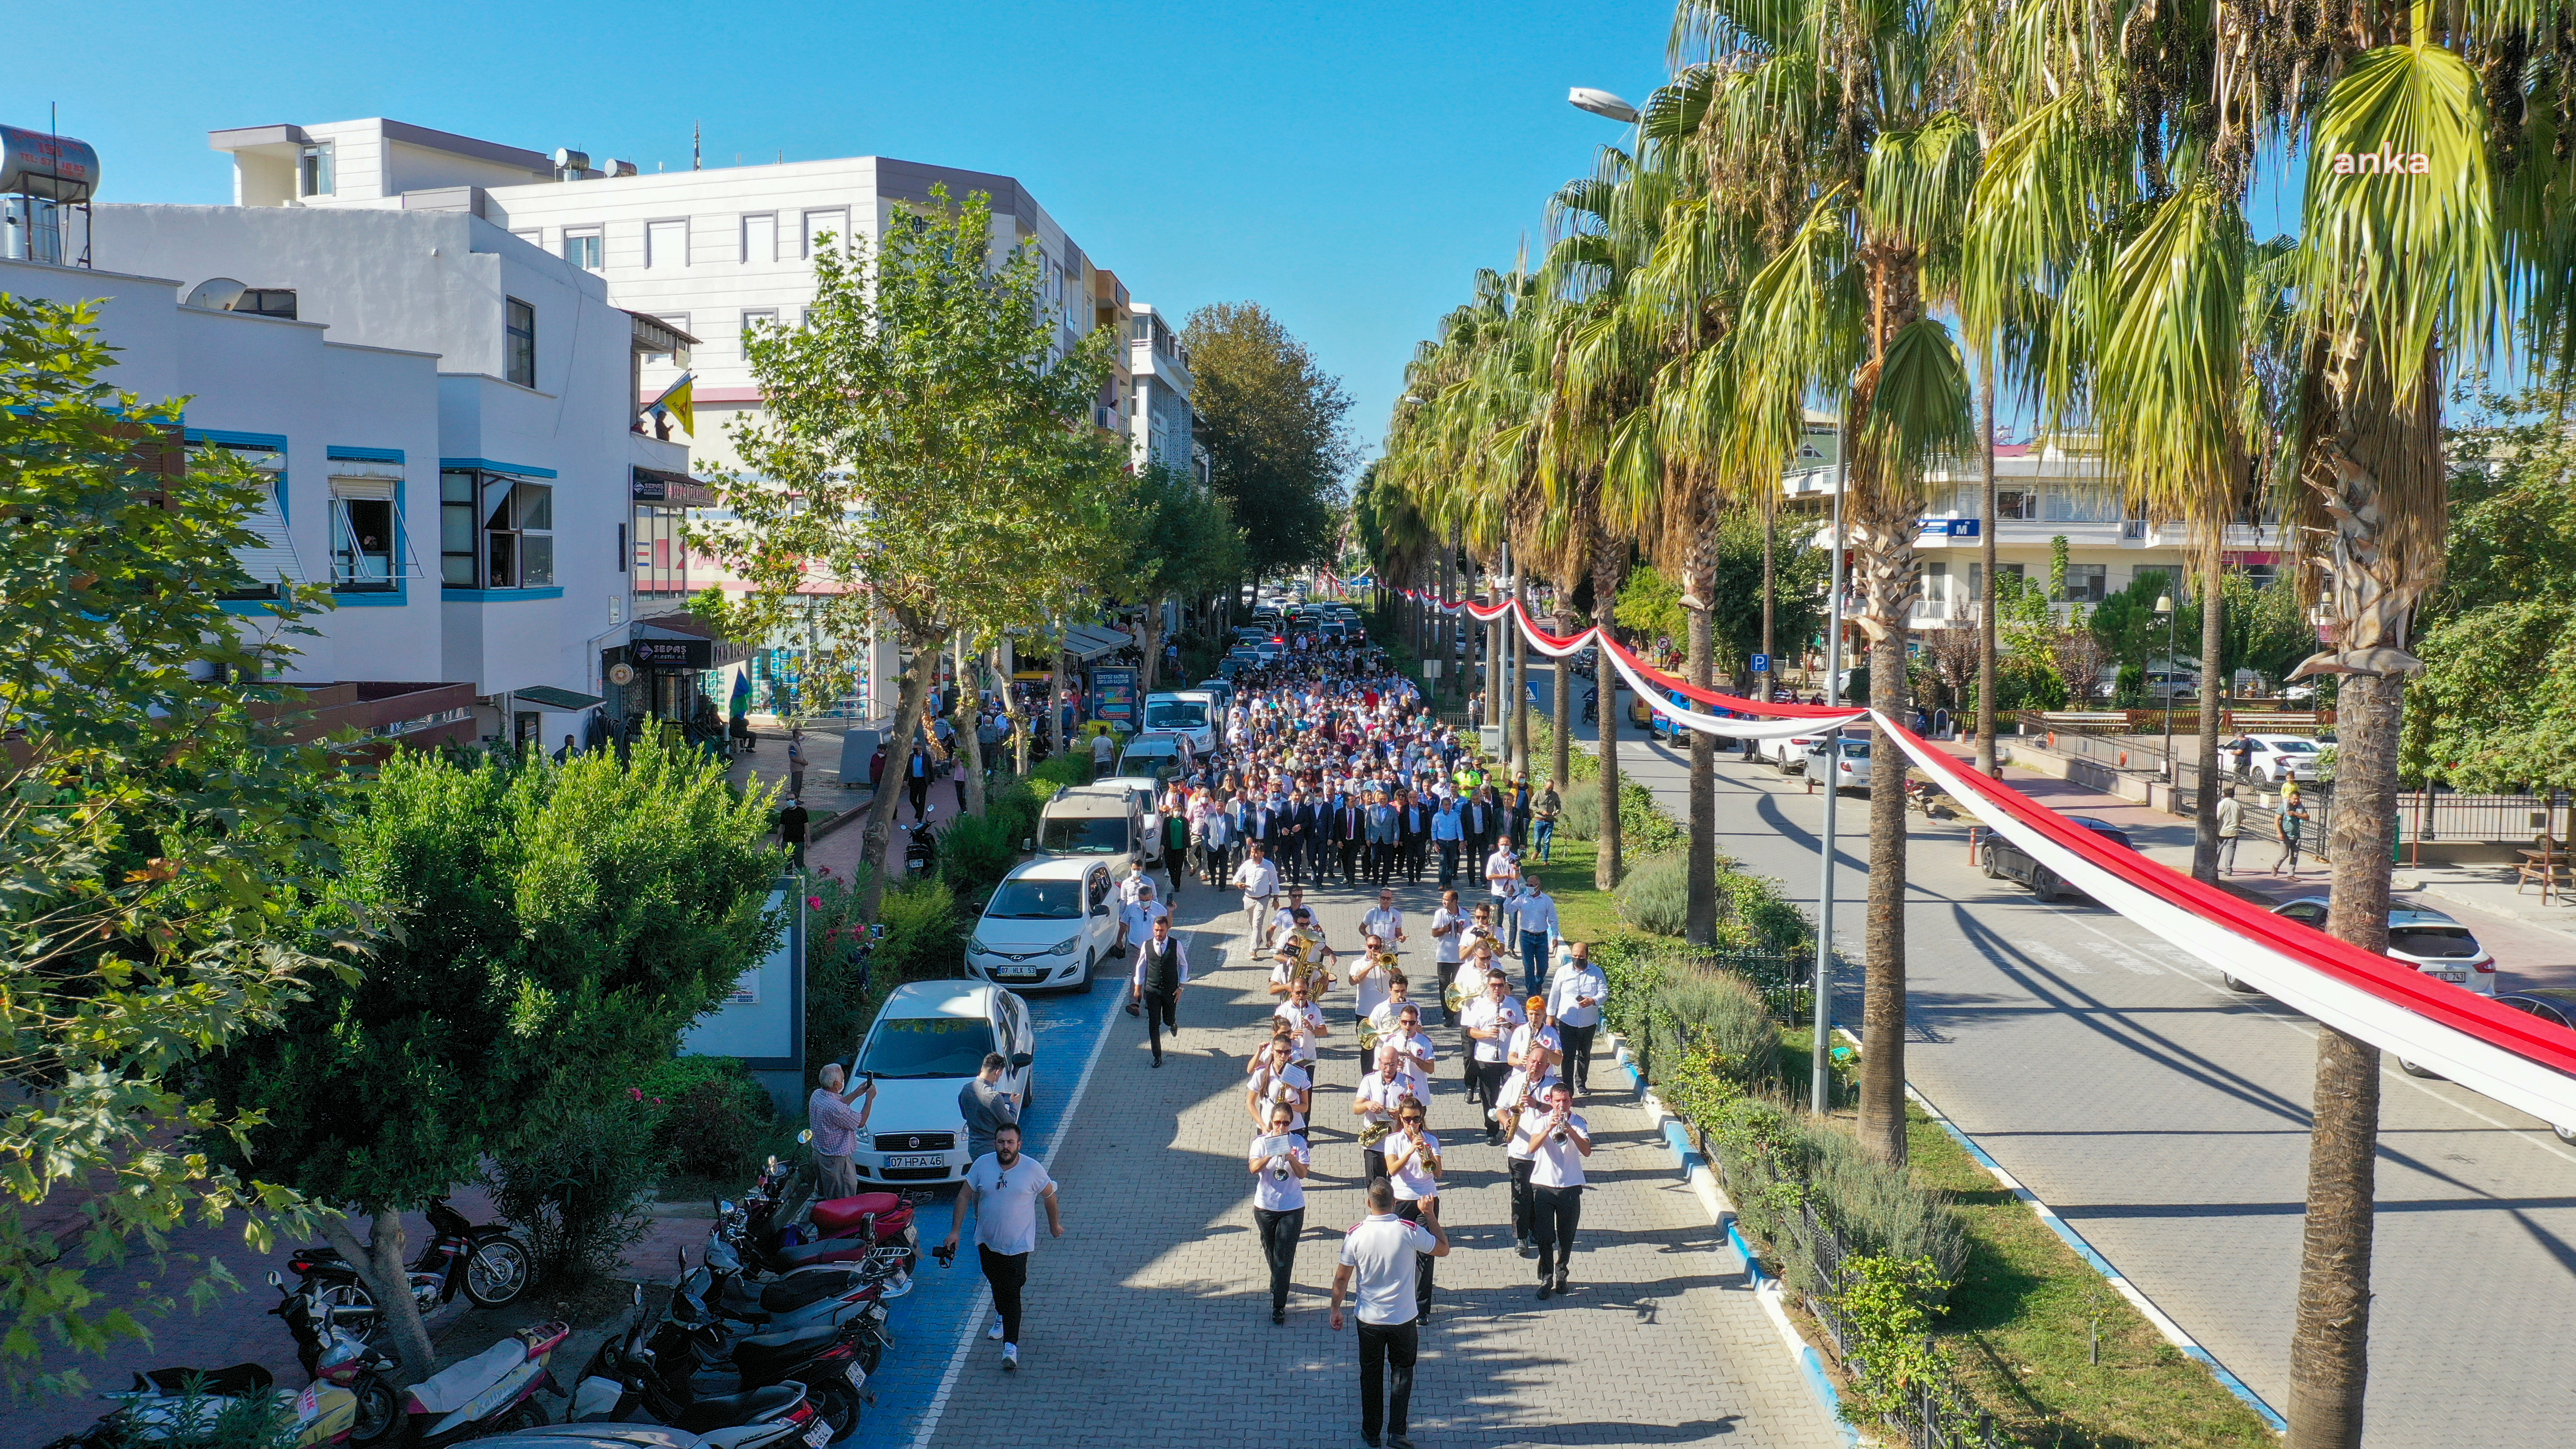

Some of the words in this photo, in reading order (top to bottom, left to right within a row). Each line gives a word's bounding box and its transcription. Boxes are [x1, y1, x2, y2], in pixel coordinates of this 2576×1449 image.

[654, 645, 686, 655] SEPAŞ
[1755, 656, 1764, 669] P
[891, 1158, 902, 1167] 07
[905, 1157, 927, 1167] HPA
[930, 1157, 942, 1166] 46
[847, 1369, 854, 1379] 07
[855, 1373, 863, 1385] 506
[816, 1431, 829, 1446] 654
